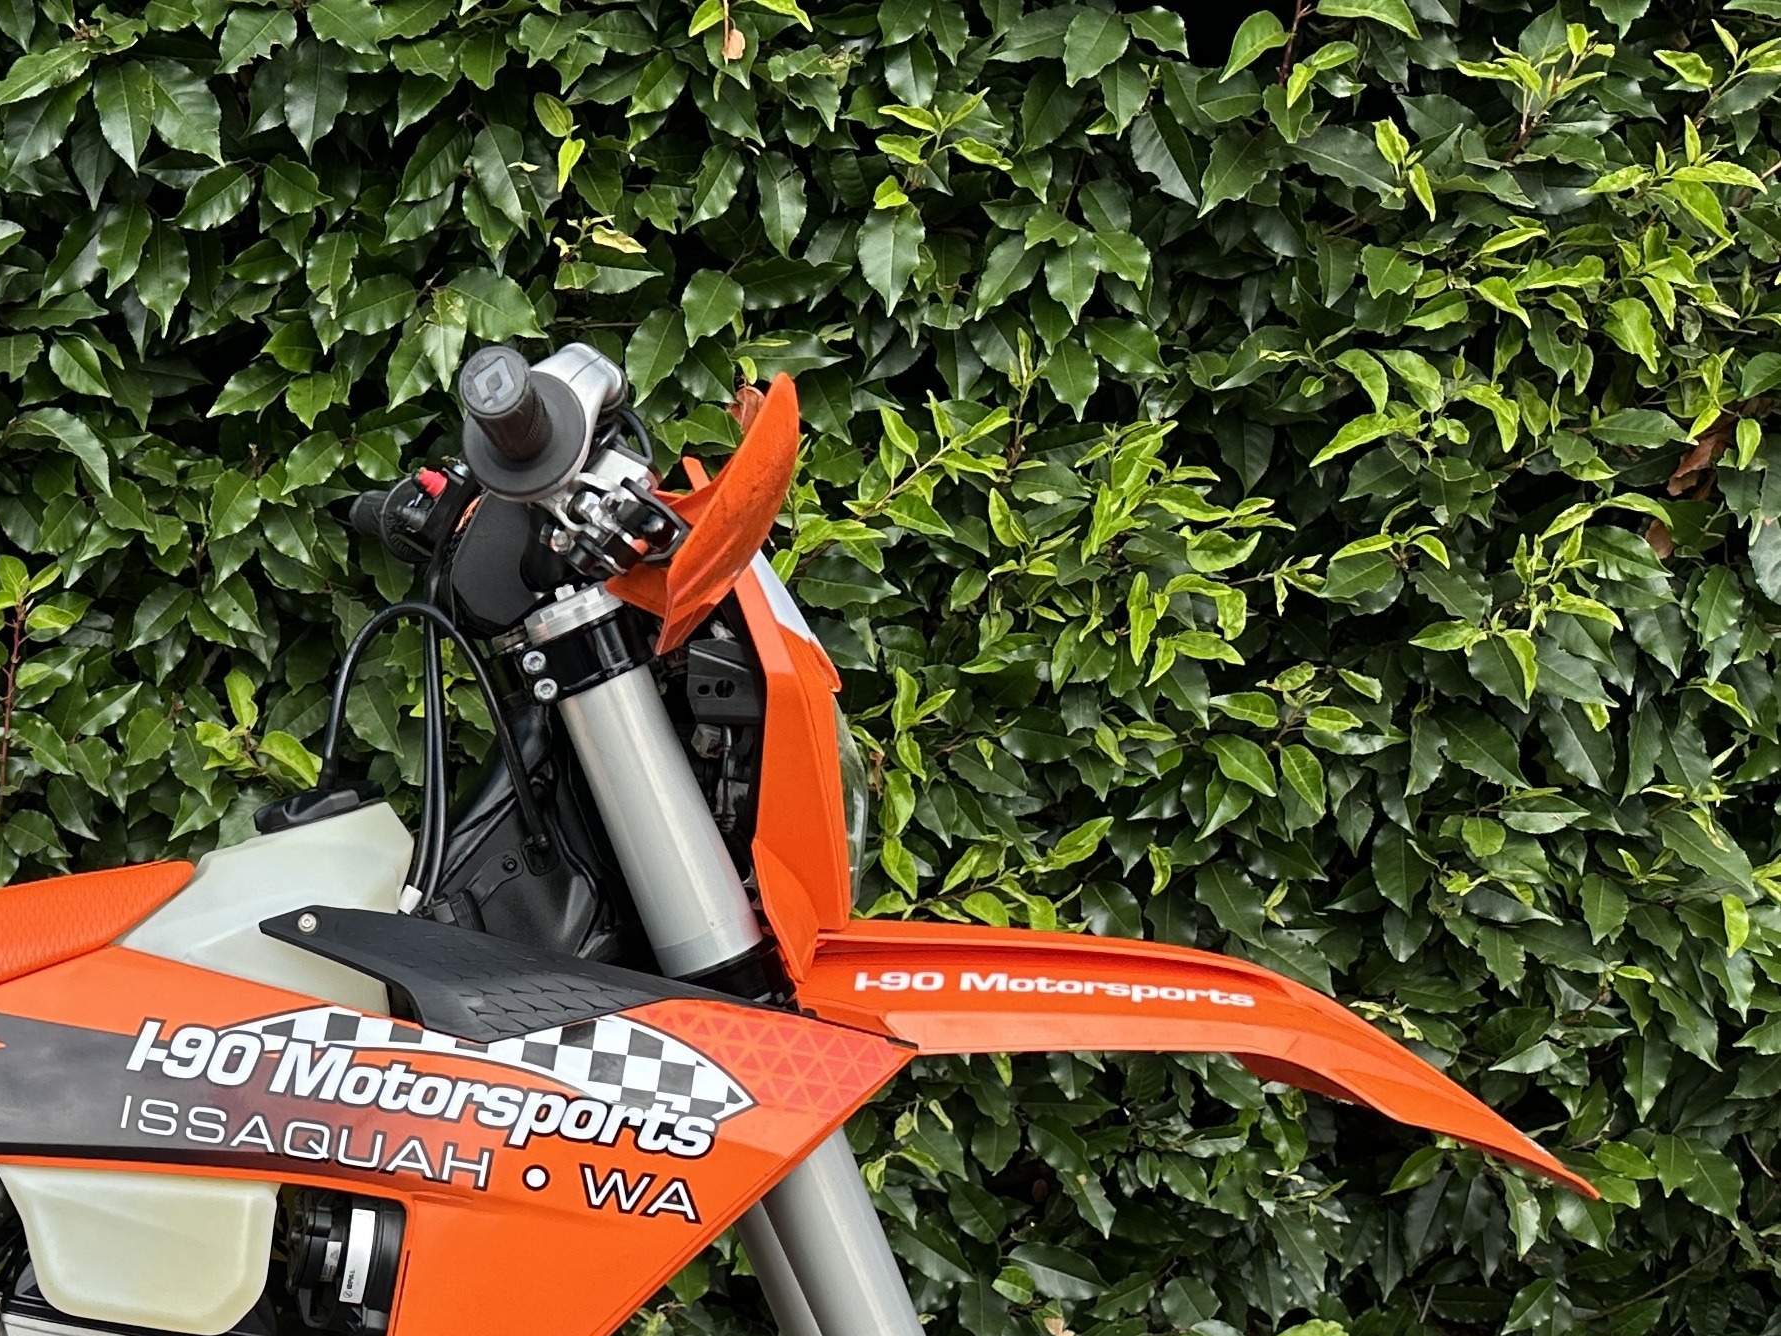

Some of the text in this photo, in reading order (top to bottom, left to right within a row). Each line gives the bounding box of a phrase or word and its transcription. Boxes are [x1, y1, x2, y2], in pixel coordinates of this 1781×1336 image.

[853, 971, 1256, 1007] I-90 Motorsports
[124, 1018, 716, 1157] I-90 Motorsports
[120, 1095, 697, 1221] ISSAQUAH WA
